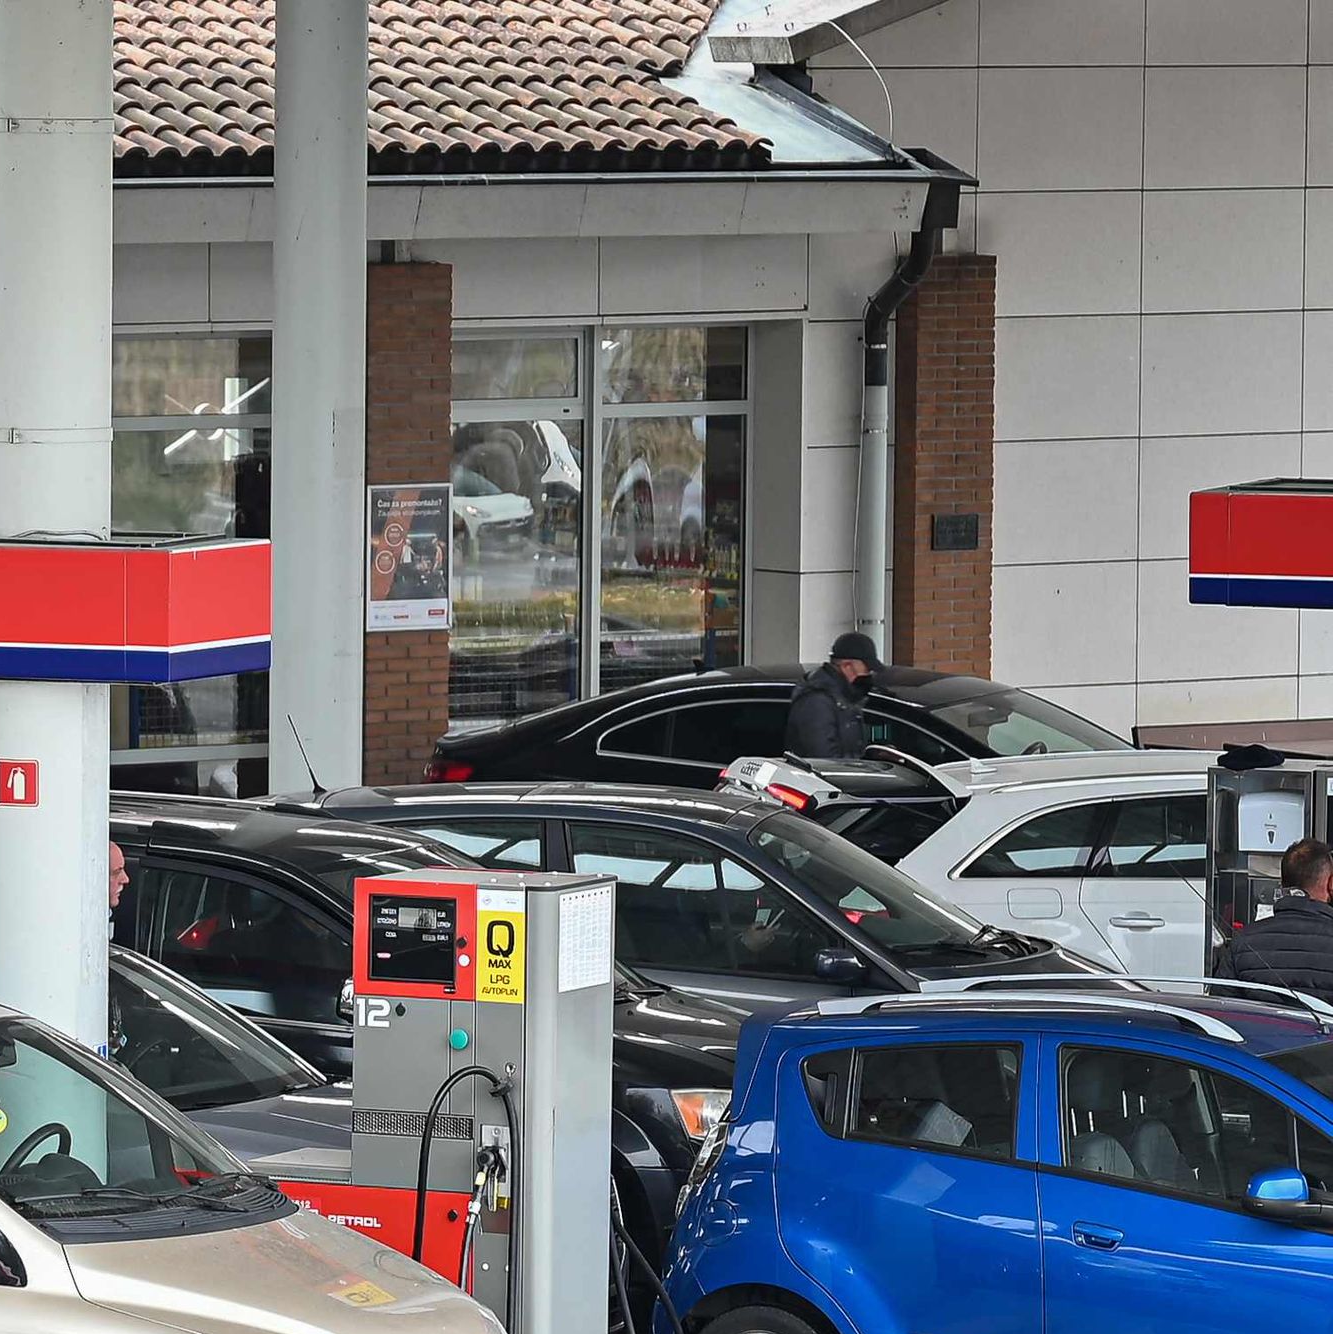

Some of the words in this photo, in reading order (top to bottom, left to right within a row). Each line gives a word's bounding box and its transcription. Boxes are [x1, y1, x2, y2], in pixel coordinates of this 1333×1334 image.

[486, 920, 515, 958] Q
[488, 959, 512, 970] MAX
[490, 974, 510, 985] LPG
[355, 998, 391, 1028] 12
[327, 1214, 381, 1228] PETROL
